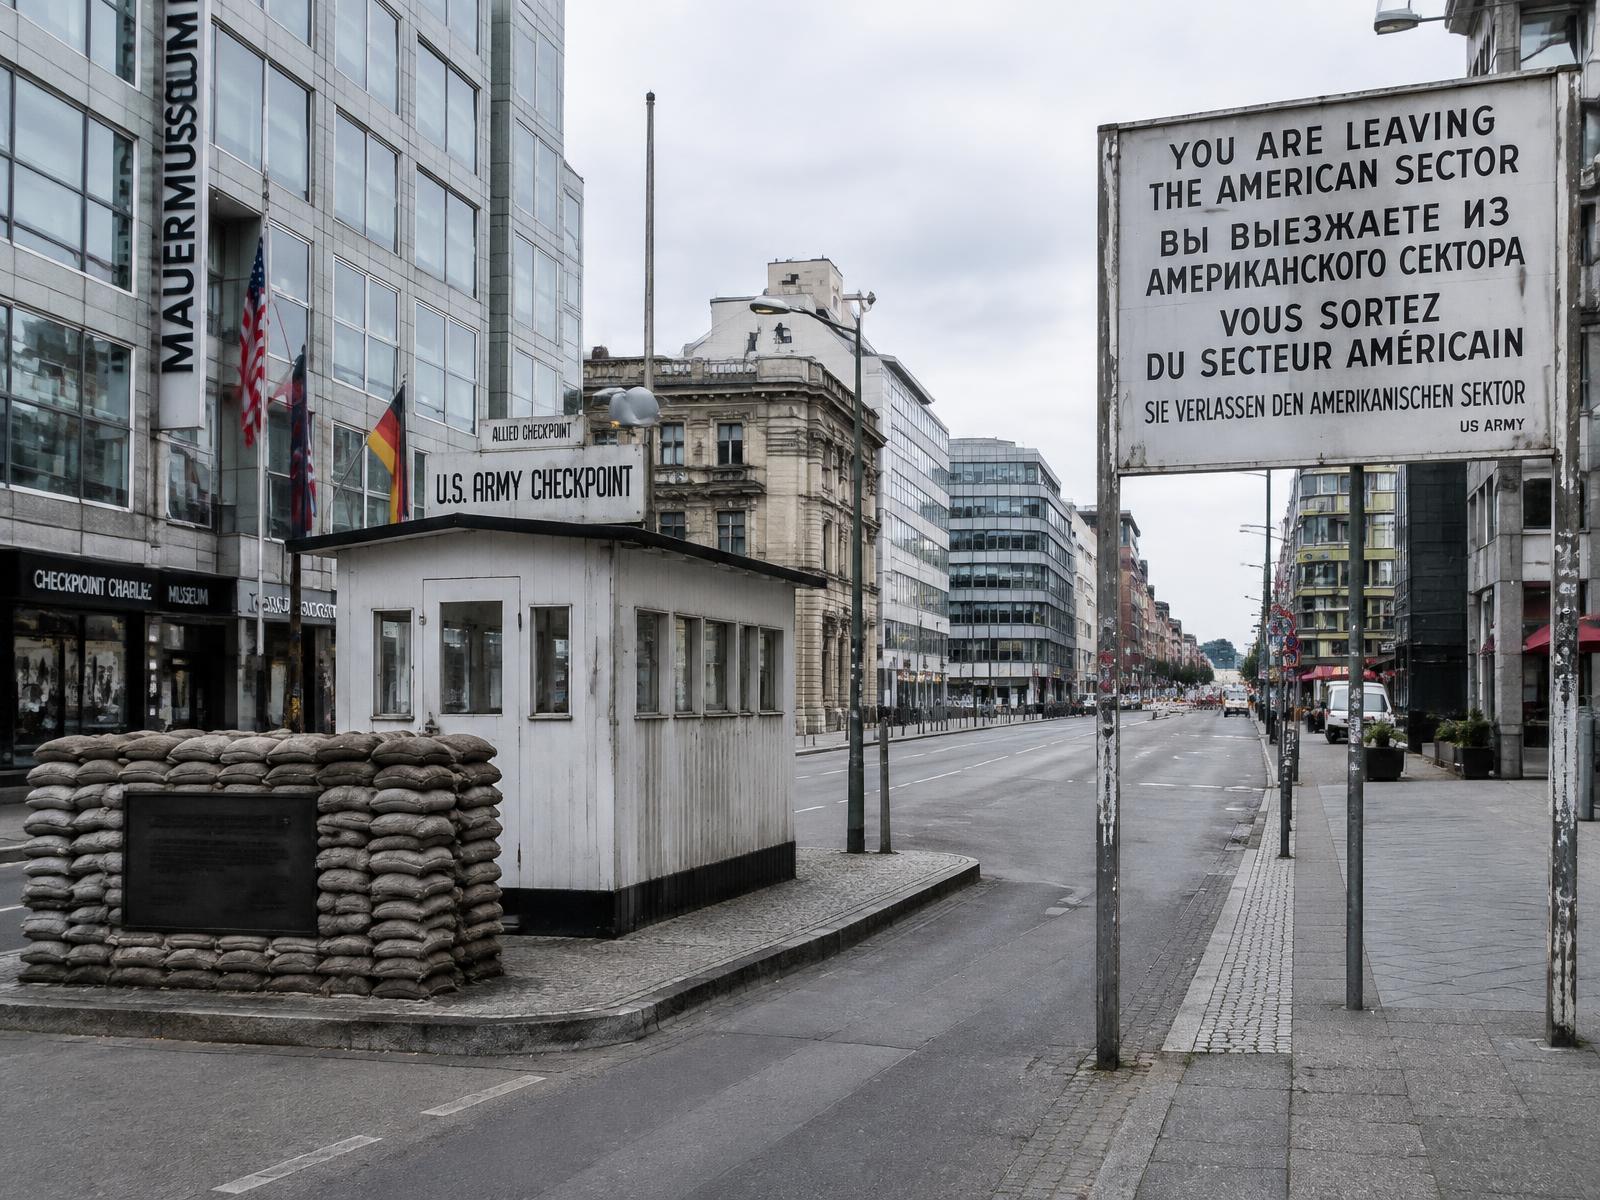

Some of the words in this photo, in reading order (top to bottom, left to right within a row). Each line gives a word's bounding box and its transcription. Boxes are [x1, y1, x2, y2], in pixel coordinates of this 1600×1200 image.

[1170, 137, 1234, 170] YOU
[1256, 126, 1322, 160] ARE
[1347, 106, 1494, 150] LEAVING
[1150, 179, 1201, 210] THE
[1216, 160, 1377, 204] AMERICAN
[1395, 145, 1518, 185] SECTOR
[1161, 227, 1207, 257] ВЫ
[1232, 203, 1440, 251] ВЫЕЗЖАЕТЕ
[1465, 197, 1509, 228] ИЗ
[1146, 248, 1385, 296] АМЕРИКАНСКОГО
[1400, 237, 1525, 275] СЕКТОРА
[1220, 304, 1302, 336] VOUS
[1320, 293, 1440, 330] SORTEZ
[1148, 351, 1184, 380] DU
[1201, 342, 1331, 377] SECTEUR
[1346, 328, 1522, 368] AMÉRICAIN
[1145, 401, 1169, 423] SIE
[1176, 395, 1264, 422] VERLASSEN
[1273, 392, 1303, 416] DEN
[1310, 384, 1453, 414] AMERIKANISCHEN
[1461, 380, 1525, 407] SEKTOR
[493, 425, 518, 442] ALLIED
[523, 422, 571, 440] CHECKPOINT
[1461, 420, 1478, 432] US
[1485, 419, 1524, 431] ARMY
[437, 473, 466, 504] U.S.
[474, 471, 522, 502] ARMY
[532, 465, 632, 500] CHECKPOINT
